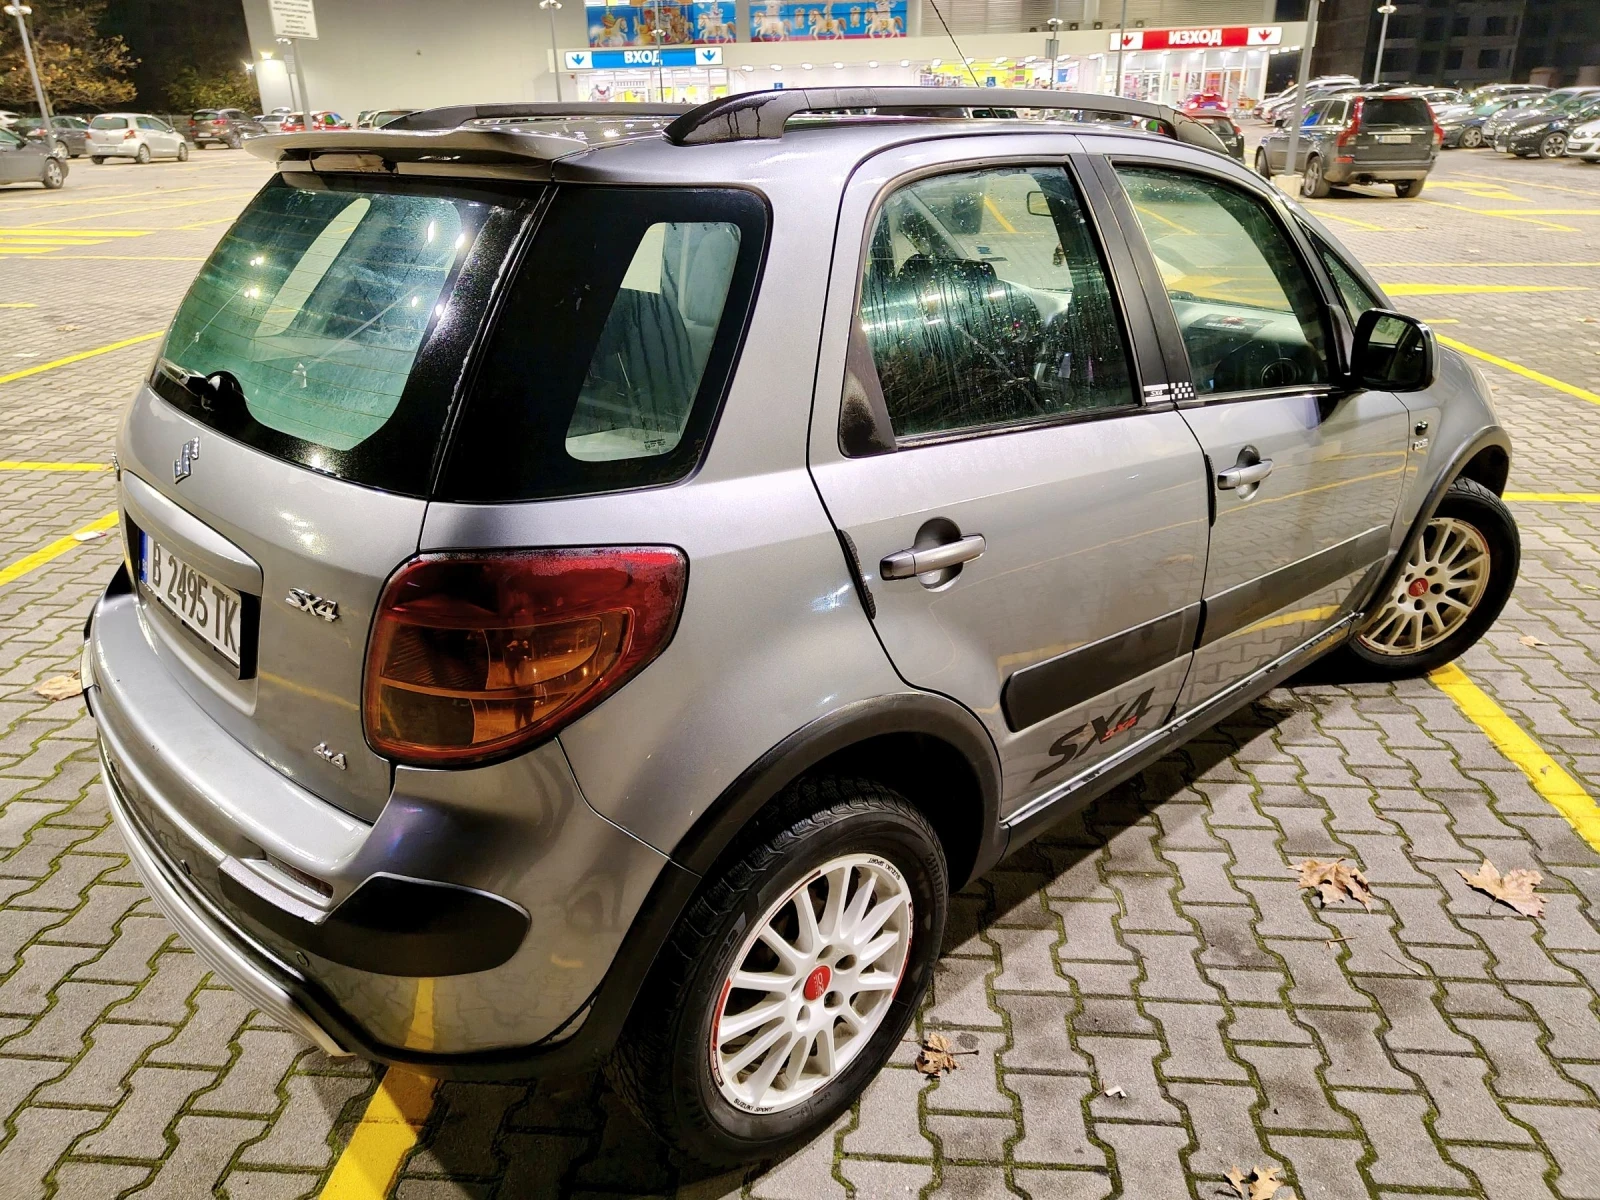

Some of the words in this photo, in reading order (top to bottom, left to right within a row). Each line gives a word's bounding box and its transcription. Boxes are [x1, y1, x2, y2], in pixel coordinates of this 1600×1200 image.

[1168, 29, 1222, 46] ИЗХОД
[623, 50, 663, 66] ВХОД
[152, 538, 161, 588] B
[167, 555, 208, 629] 2495
[212, 586, 239, 654] TK
[285, 587, 340, 623] SX4
[1030, 686, 1154, 784] SX4
[733, 1097, 755, 1111] SUZUKI
[753, 1105, 775, 1113] SPORT
